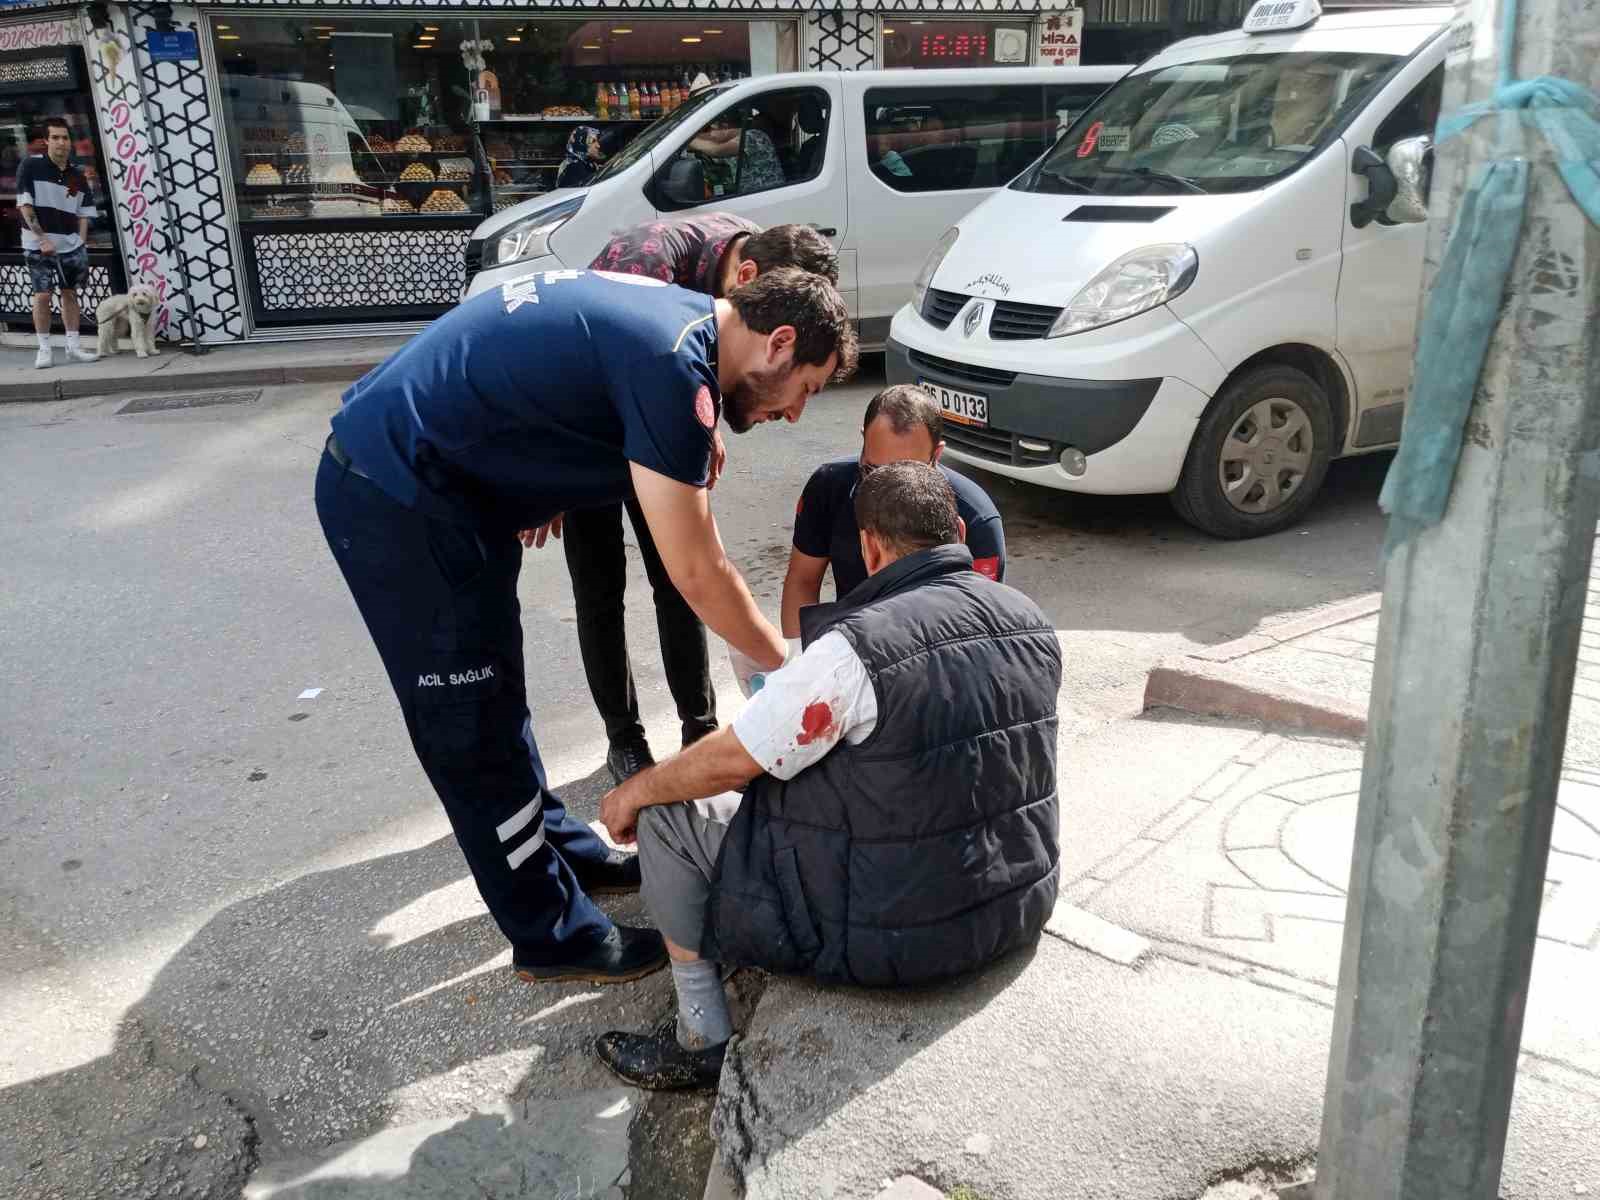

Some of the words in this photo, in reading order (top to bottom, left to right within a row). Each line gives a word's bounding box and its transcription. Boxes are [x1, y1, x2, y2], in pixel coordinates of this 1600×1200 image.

[941, 390, 951, 409] D
[953, 394, 986, 420] 0133
[418, 672, 445, 687] ACİL
[449, 665, 495, 685] SAĞLIK
